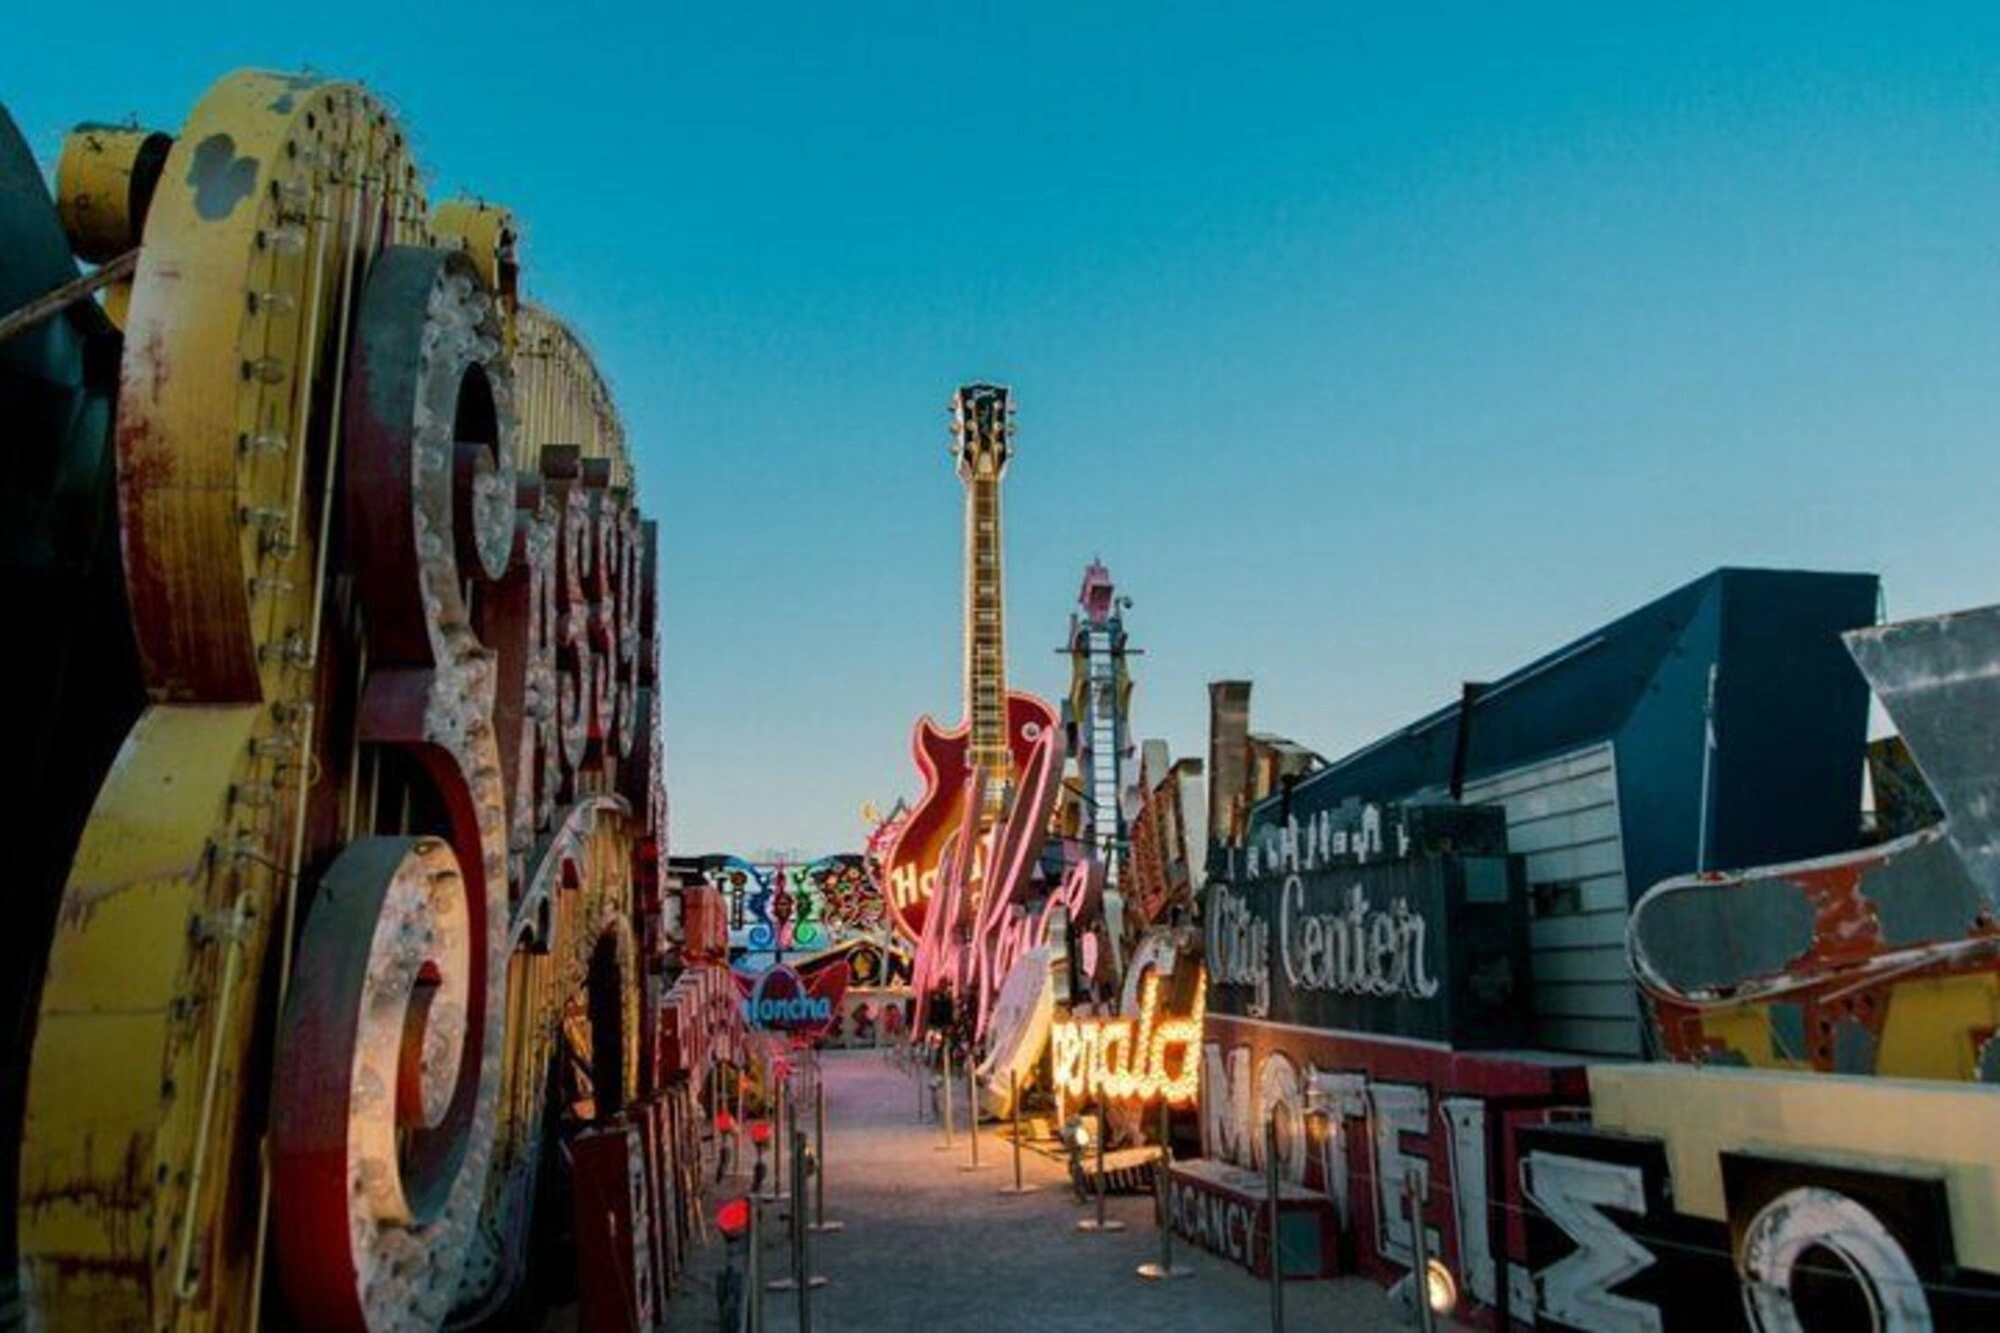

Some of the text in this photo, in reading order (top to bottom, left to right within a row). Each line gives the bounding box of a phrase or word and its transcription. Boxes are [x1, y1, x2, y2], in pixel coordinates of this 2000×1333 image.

[1204, 882, 1271, 1018] City
[1280, 874, 1440, 998] Center
[1201, 1042, 1536, 1327] MOTEL
